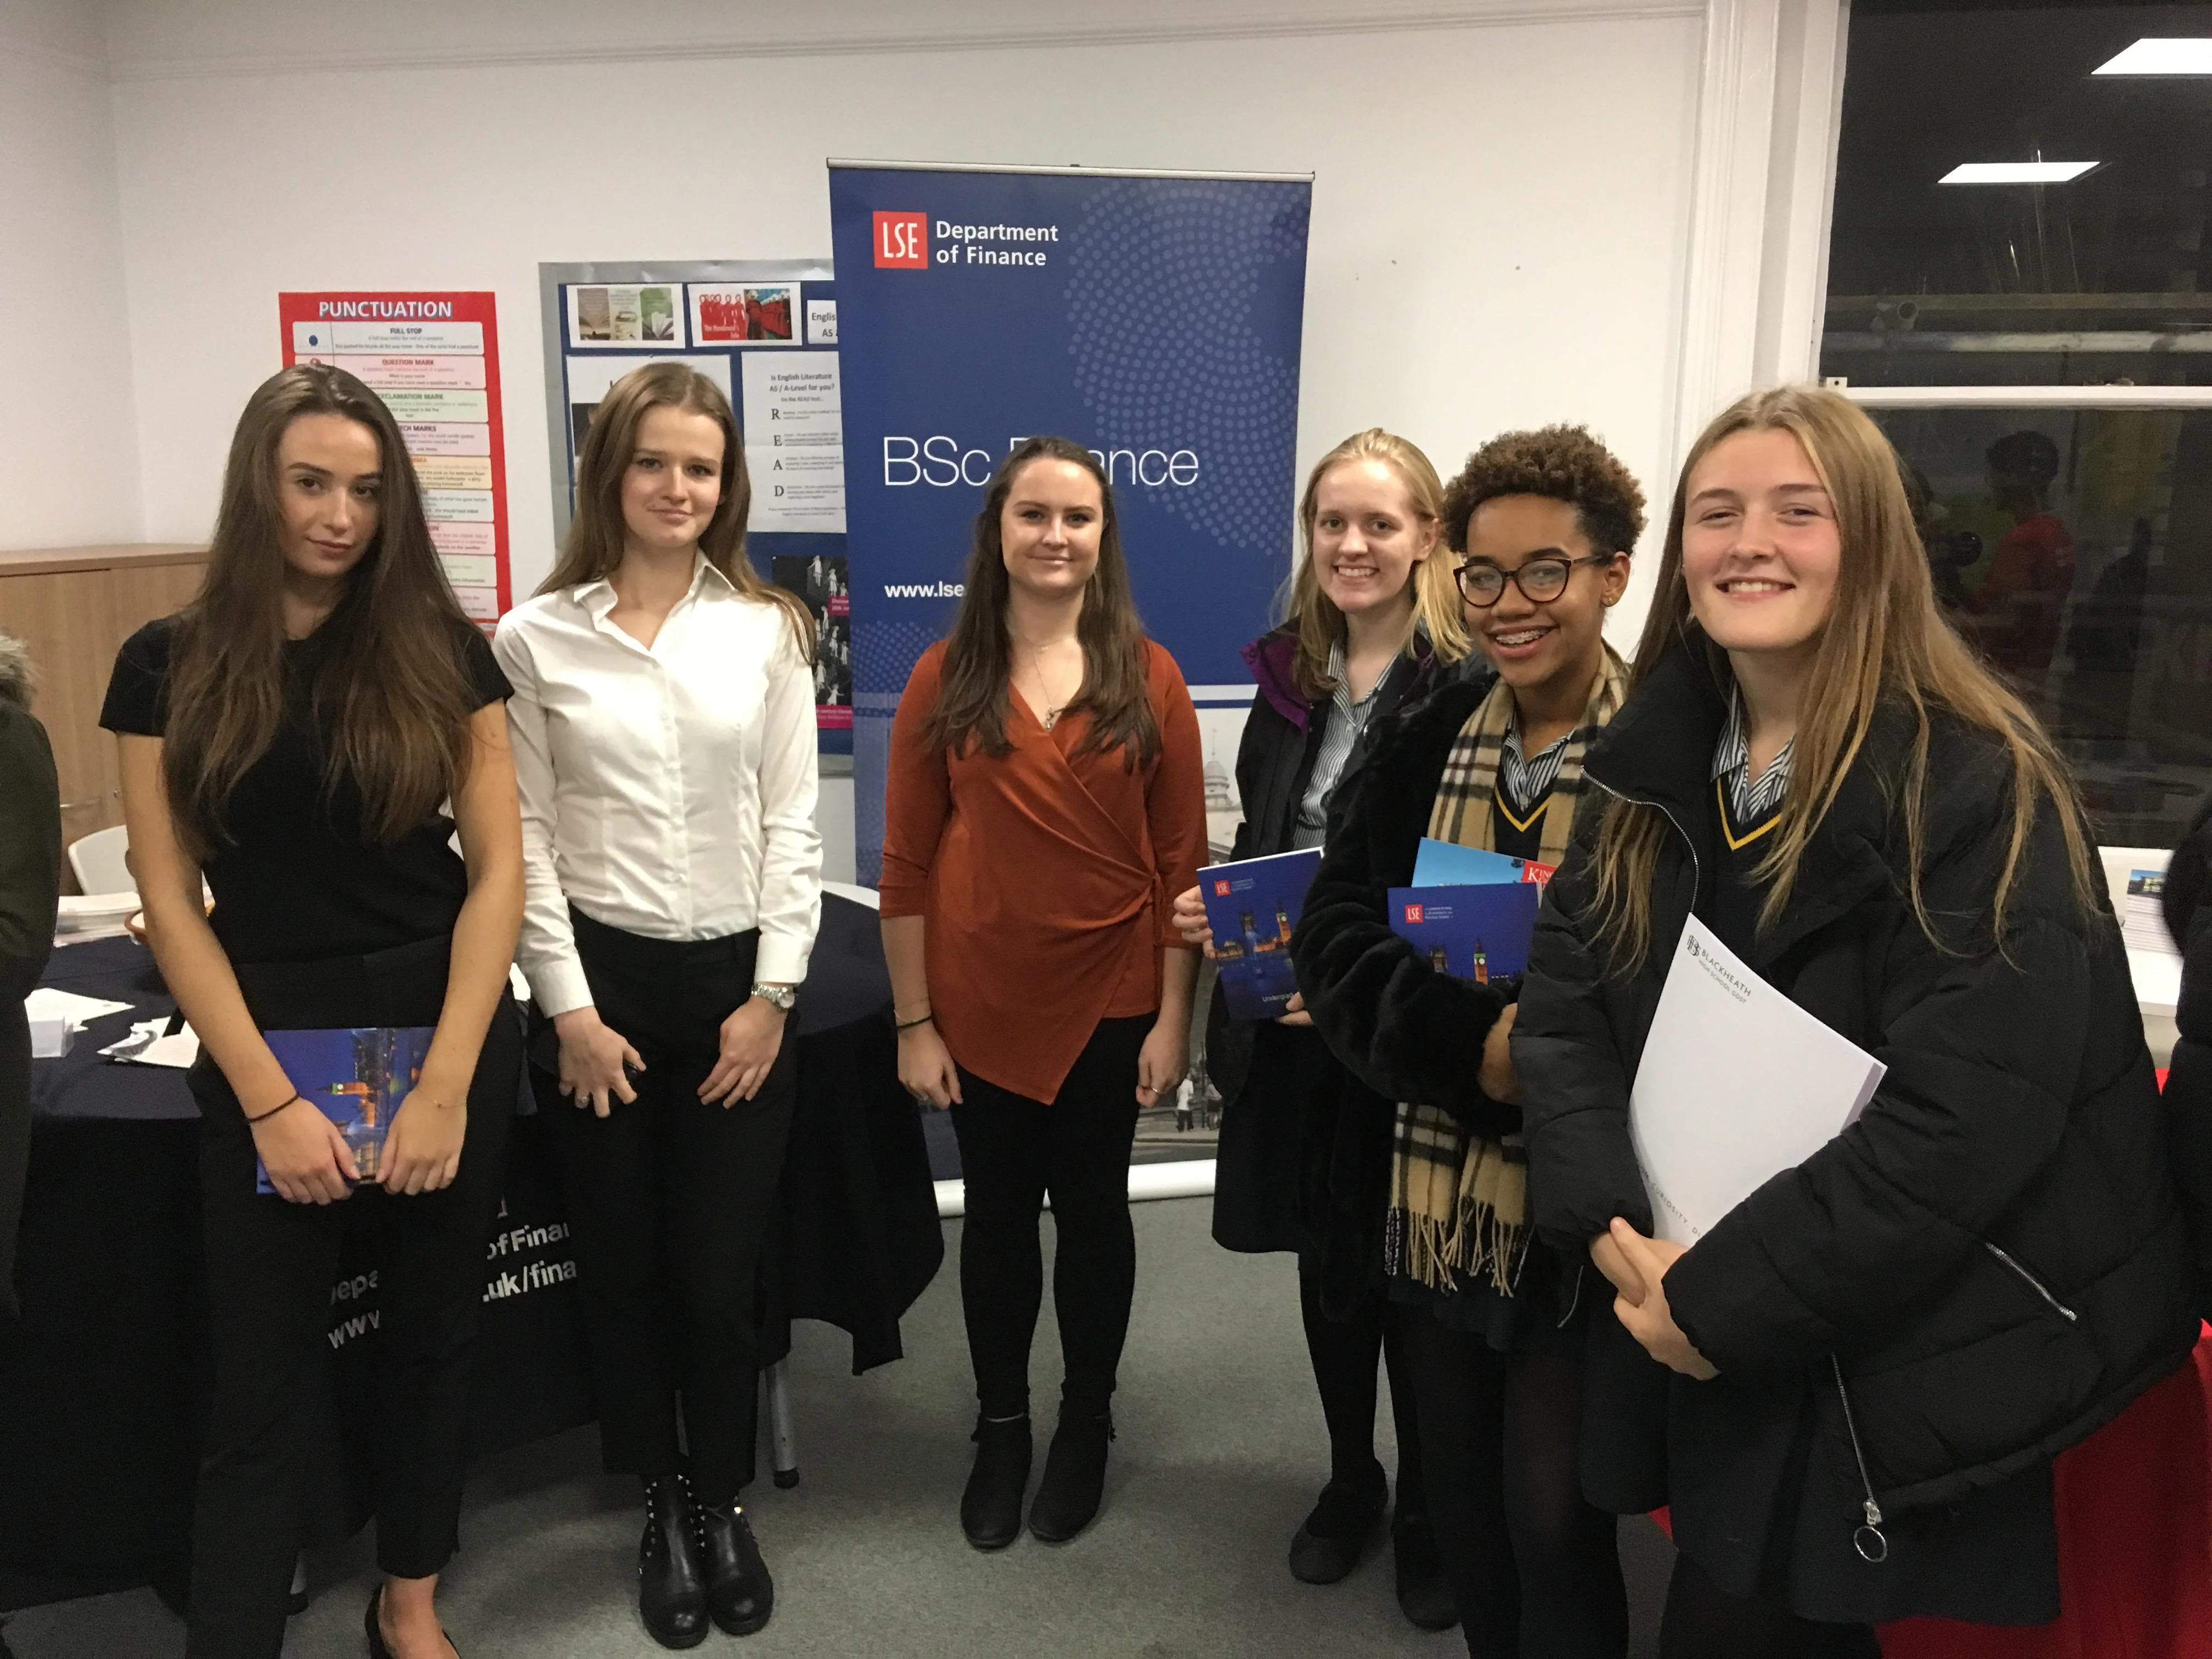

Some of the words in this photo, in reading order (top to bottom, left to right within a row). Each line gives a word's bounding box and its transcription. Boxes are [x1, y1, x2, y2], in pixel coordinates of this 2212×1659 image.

[936, 220, 1059, 243] Department
[882, 221, 919, 259] LSE
[936, 246, 958, 264] of
[967, 246, 1047, 266] Finance
[319, 301, 453, 318] PUNCTUATION
[811, 312, 836, 323] Englis
[822, 329, 833, 337] AS
[777, 373, 799, 382] English
[819, 382, 835, 391] you?
[771, 408, 781, 420] R
[774, 435, 782, 447] E
[772, 458, 783, 471] A
[883, 436, 991, 487] BSc
[774, 484, 785, 497] D
[884, 580, 965, 598] www.lse
[1407, 907, 1420, 920] LSE
[1701, 949, 1752, 997] BLACKHEATH
[1709, 970, 1730, 992] SCHOOL
[1691, 1226, 1704, 1238] DI
[482, 1260, 577, 1303] .uk/fina
